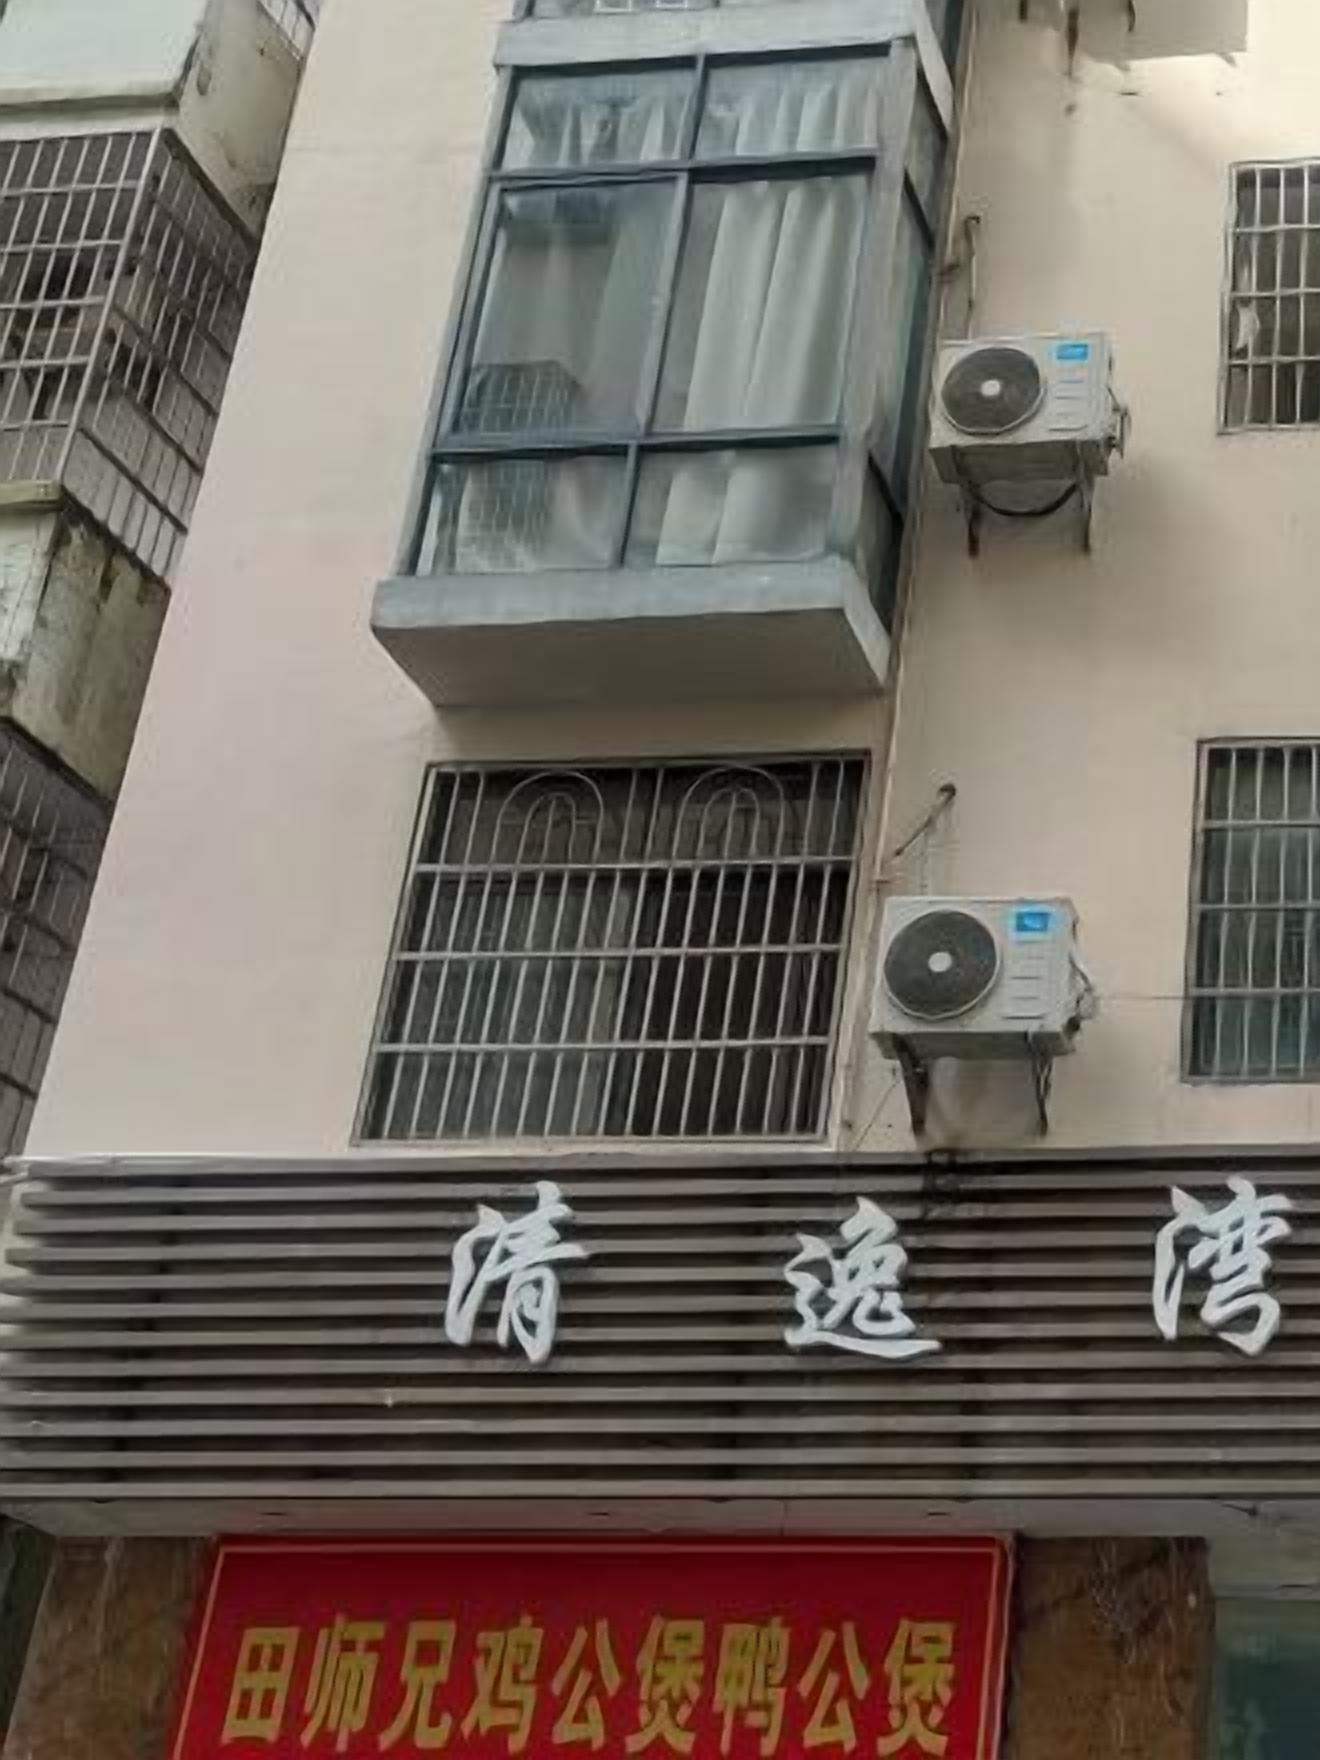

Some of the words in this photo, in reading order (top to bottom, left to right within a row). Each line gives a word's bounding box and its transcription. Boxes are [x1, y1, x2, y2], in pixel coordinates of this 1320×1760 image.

[220, 1615, 957, 1757] 田师兄鸡公煲鸭公煲
